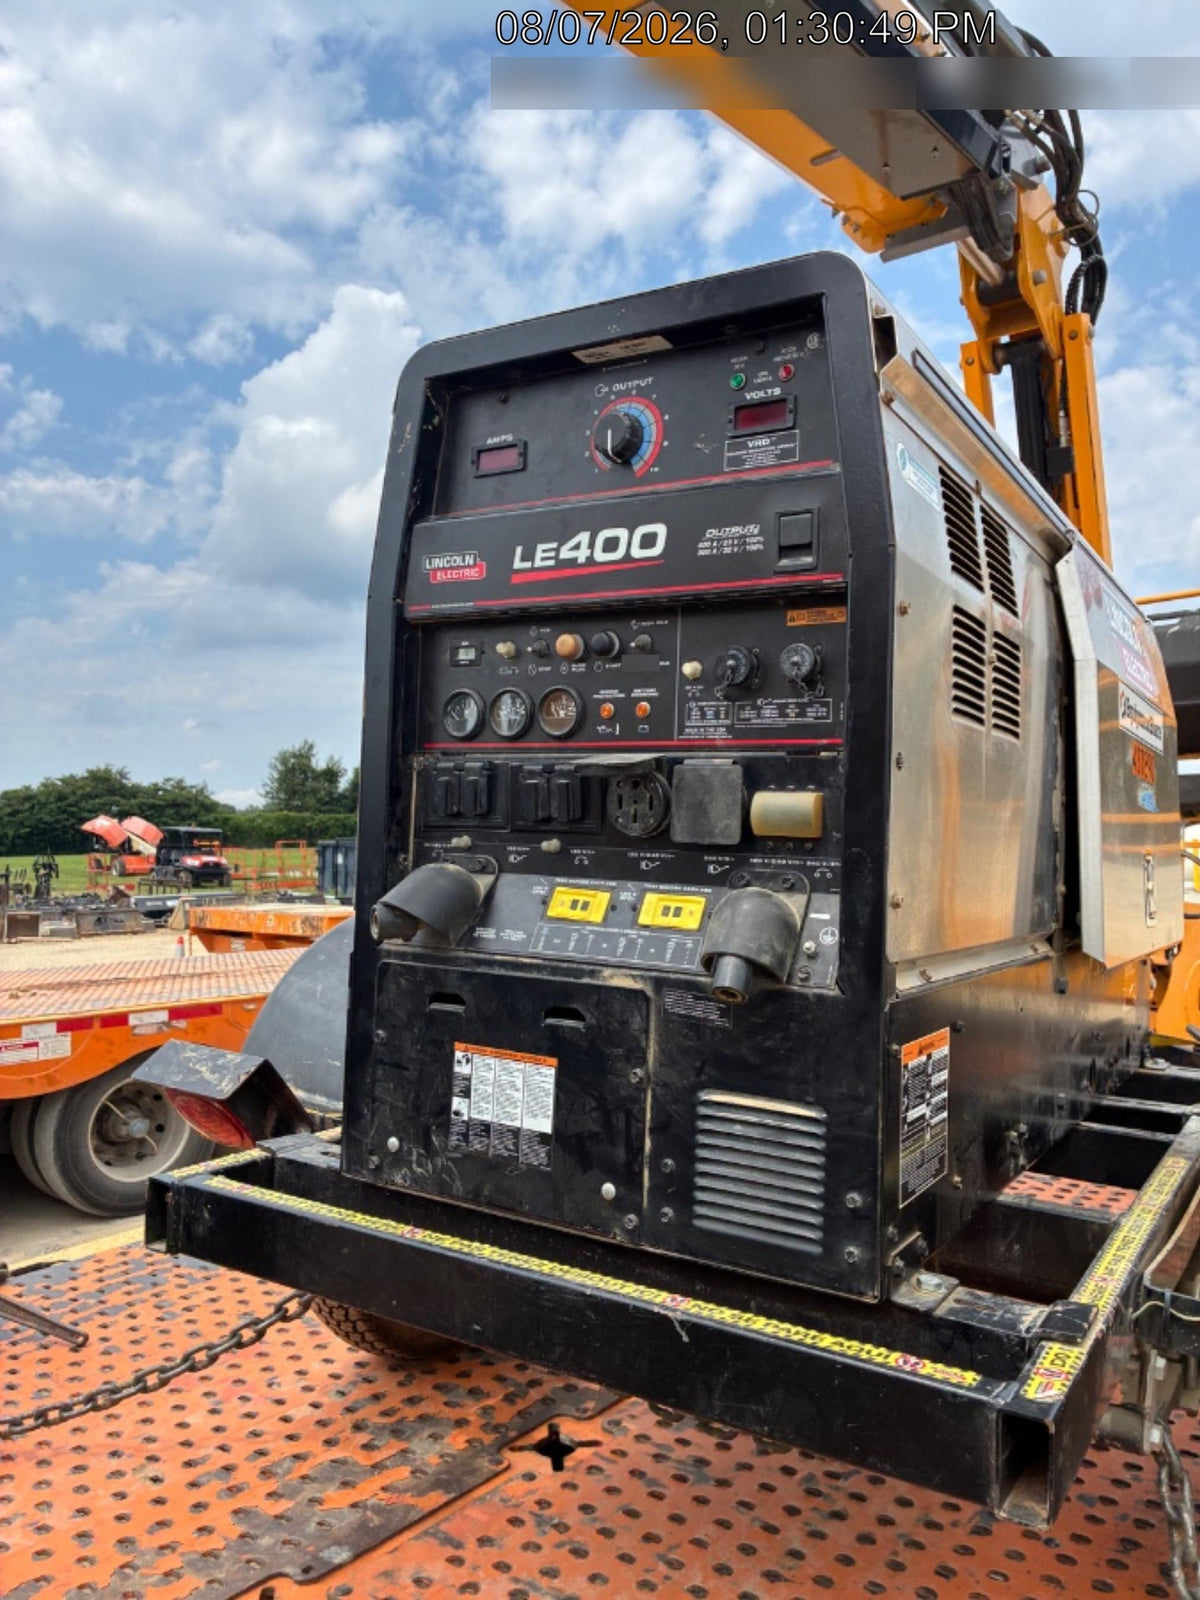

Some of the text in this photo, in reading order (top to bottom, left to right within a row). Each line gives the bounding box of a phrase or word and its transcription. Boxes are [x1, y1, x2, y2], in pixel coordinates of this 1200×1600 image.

[612, 377, 654, 392] OUTPUT
[744, 386, 781, 400] VOLTS
[486, 433, 514, 445] AMPS
[512, 522, 668, 570] LE400
[425, 554, 475, 569] LINCOLN
[437, 568, 480, 580] ELECTRIC
